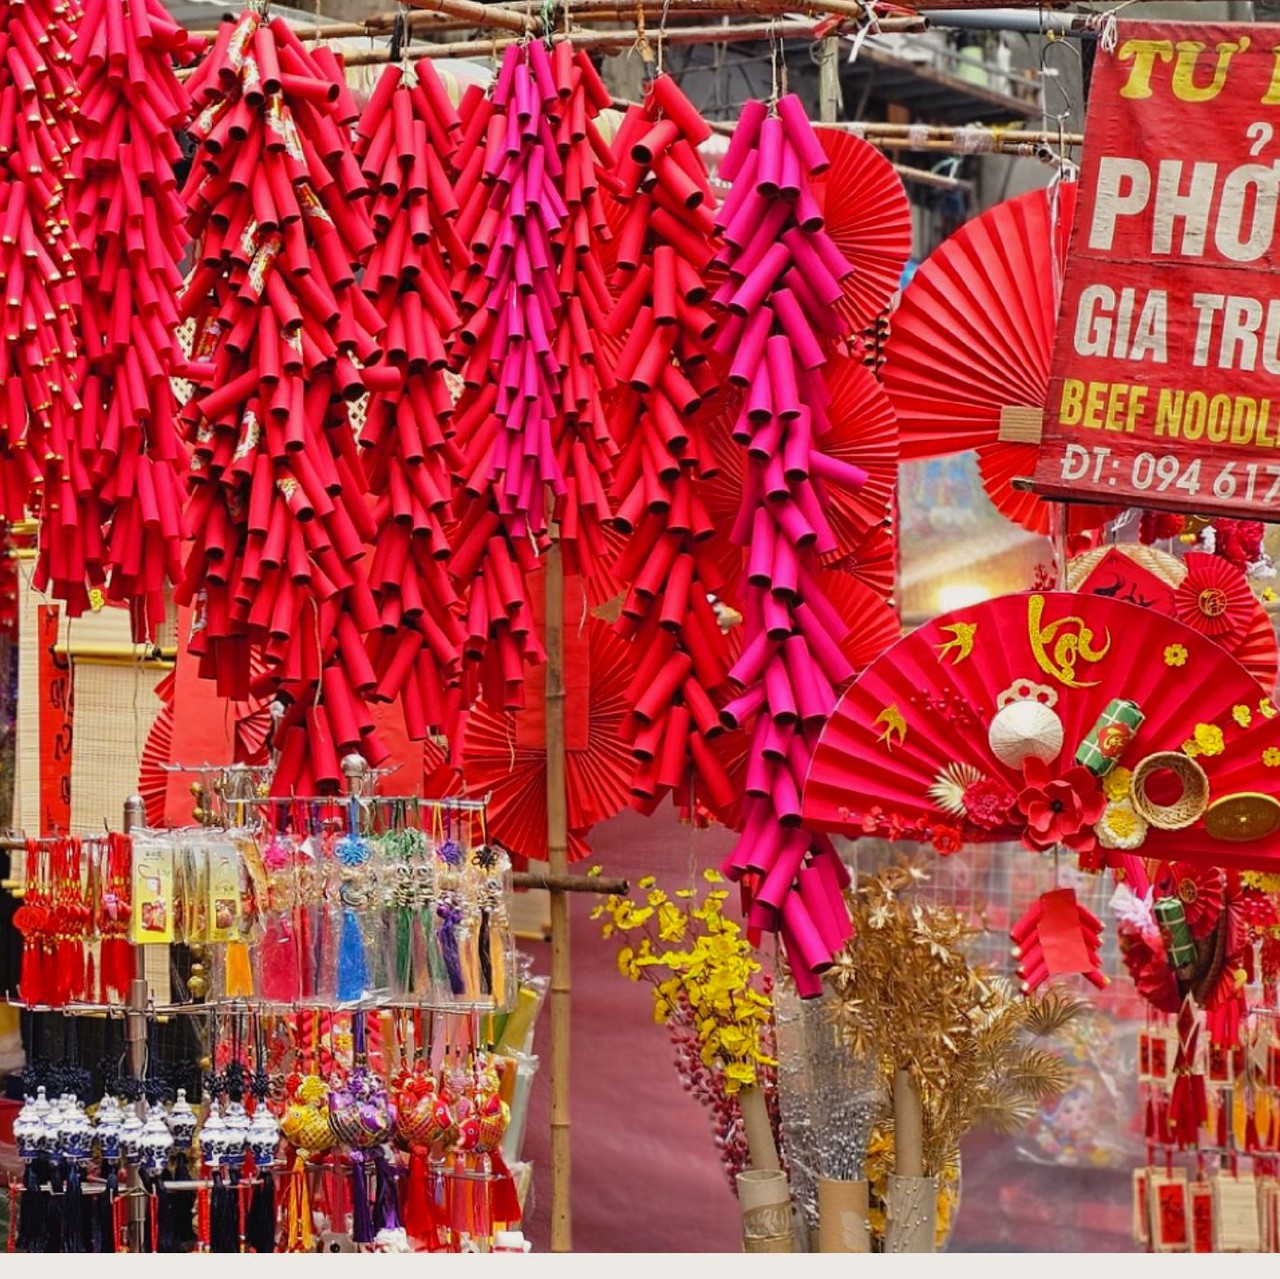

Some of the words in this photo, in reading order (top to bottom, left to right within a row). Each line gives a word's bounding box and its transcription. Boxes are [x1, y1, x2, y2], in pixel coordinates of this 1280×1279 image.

[1118, 36, 1251, 102] TƯ
[1088, 121, 1280, 262] PHỞ
[1074, 283, 1169, 363] GIA
[1059, 378, 1149, 433] BEEF
[1154, 388, 1280, 448] NOODL
[1060, 443, 1120, 486] ĐT:
[1131, 451, 1202, 495] 094
